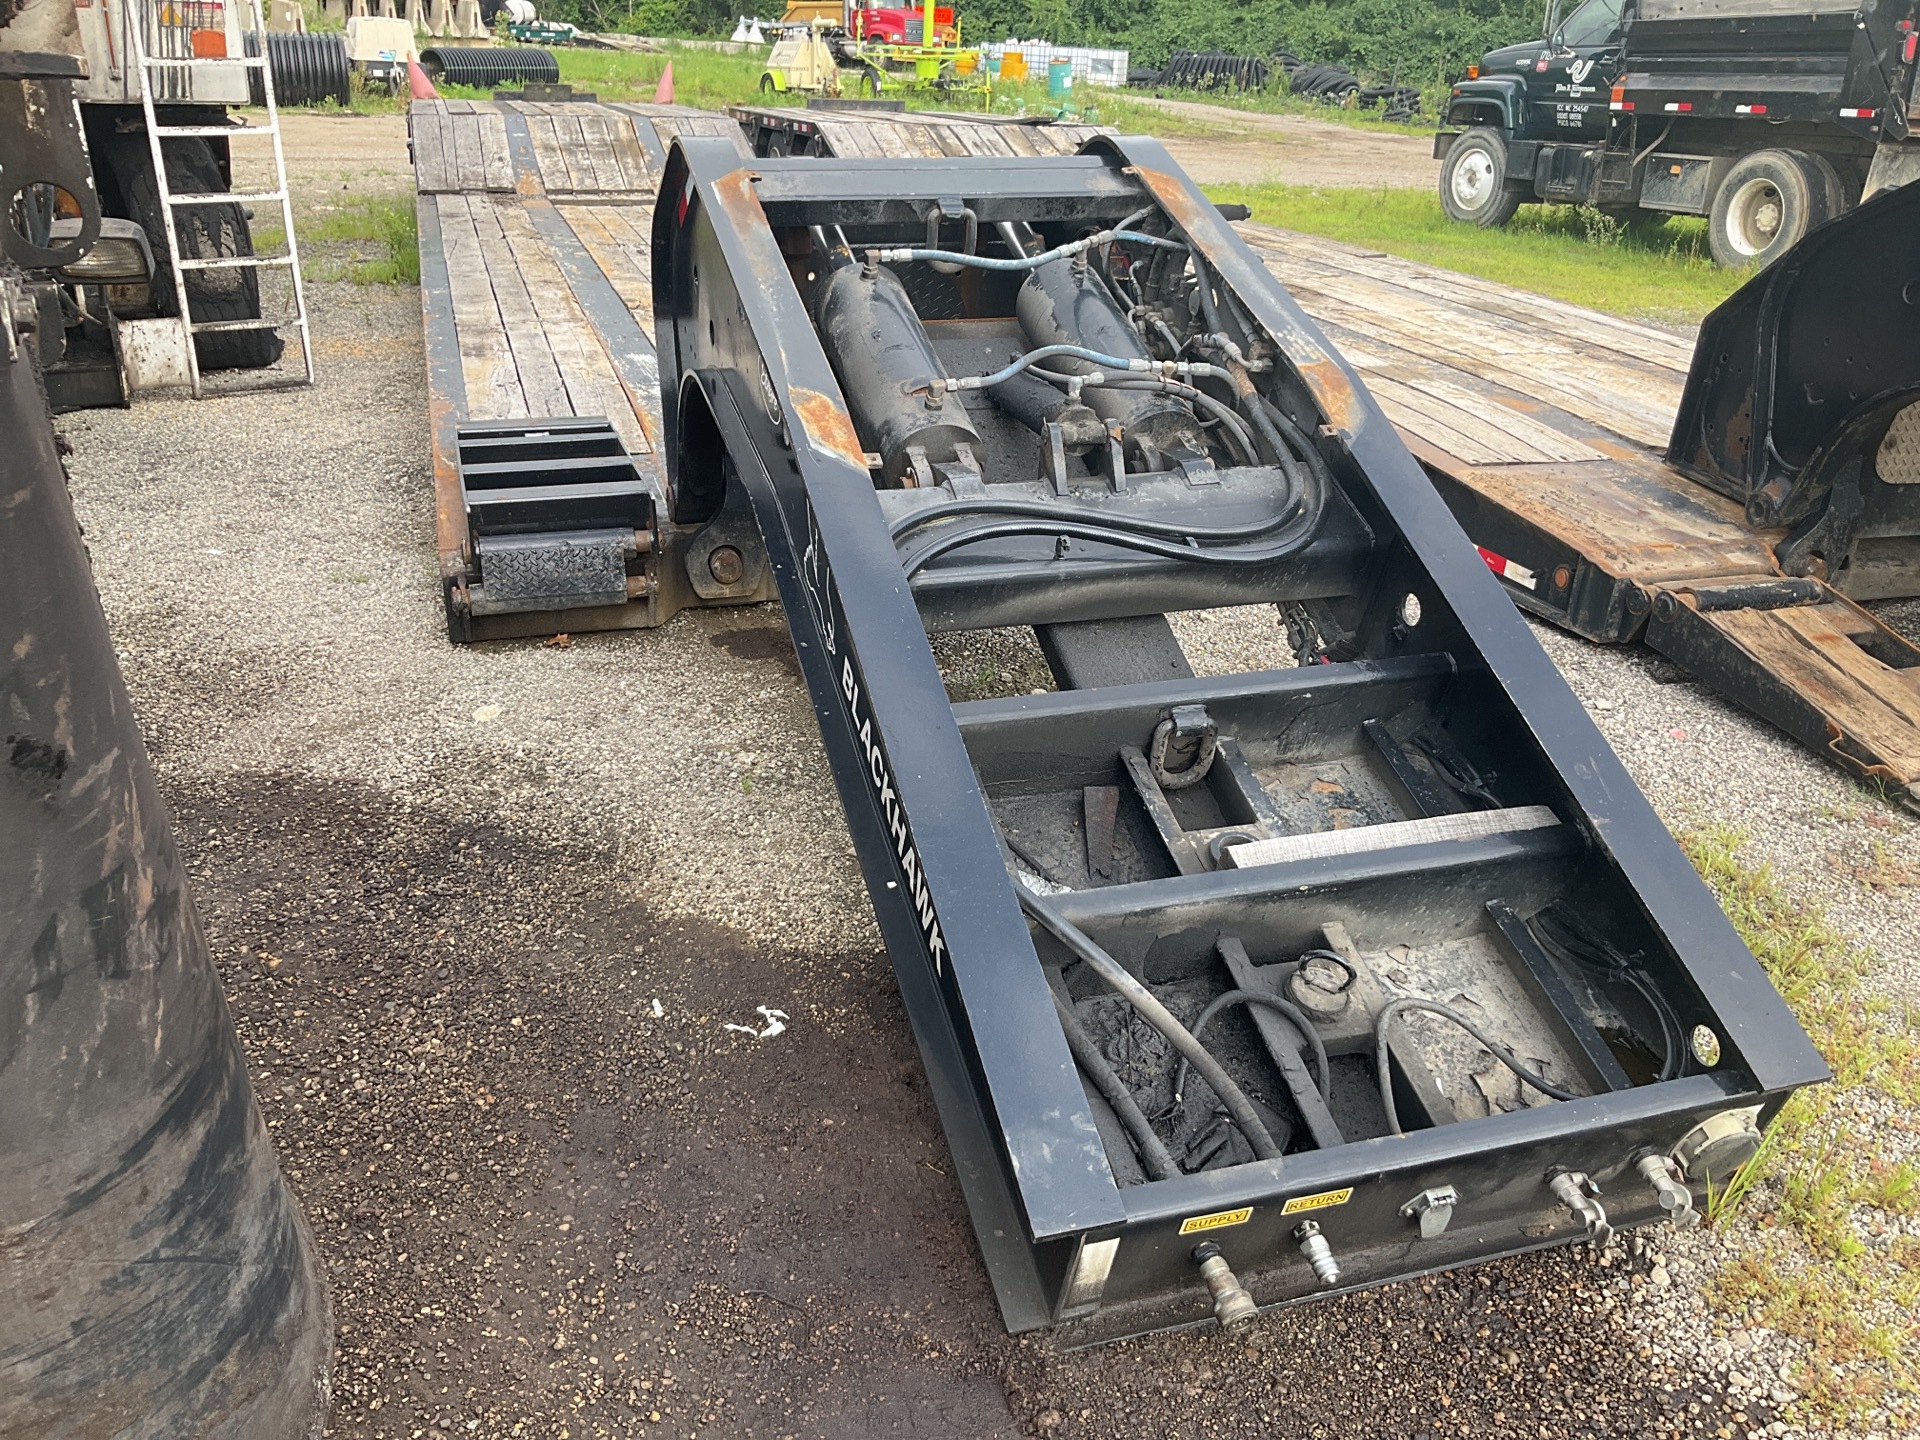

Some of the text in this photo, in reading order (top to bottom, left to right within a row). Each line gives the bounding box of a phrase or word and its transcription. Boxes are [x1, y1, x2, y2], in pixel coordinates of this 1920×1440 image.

[842, 655, 945, 978] BLACKHAWK
[1289, 1193, 1346, 1210] RETURN
[1188, 1212, 1244, 1229] SUPPLY
